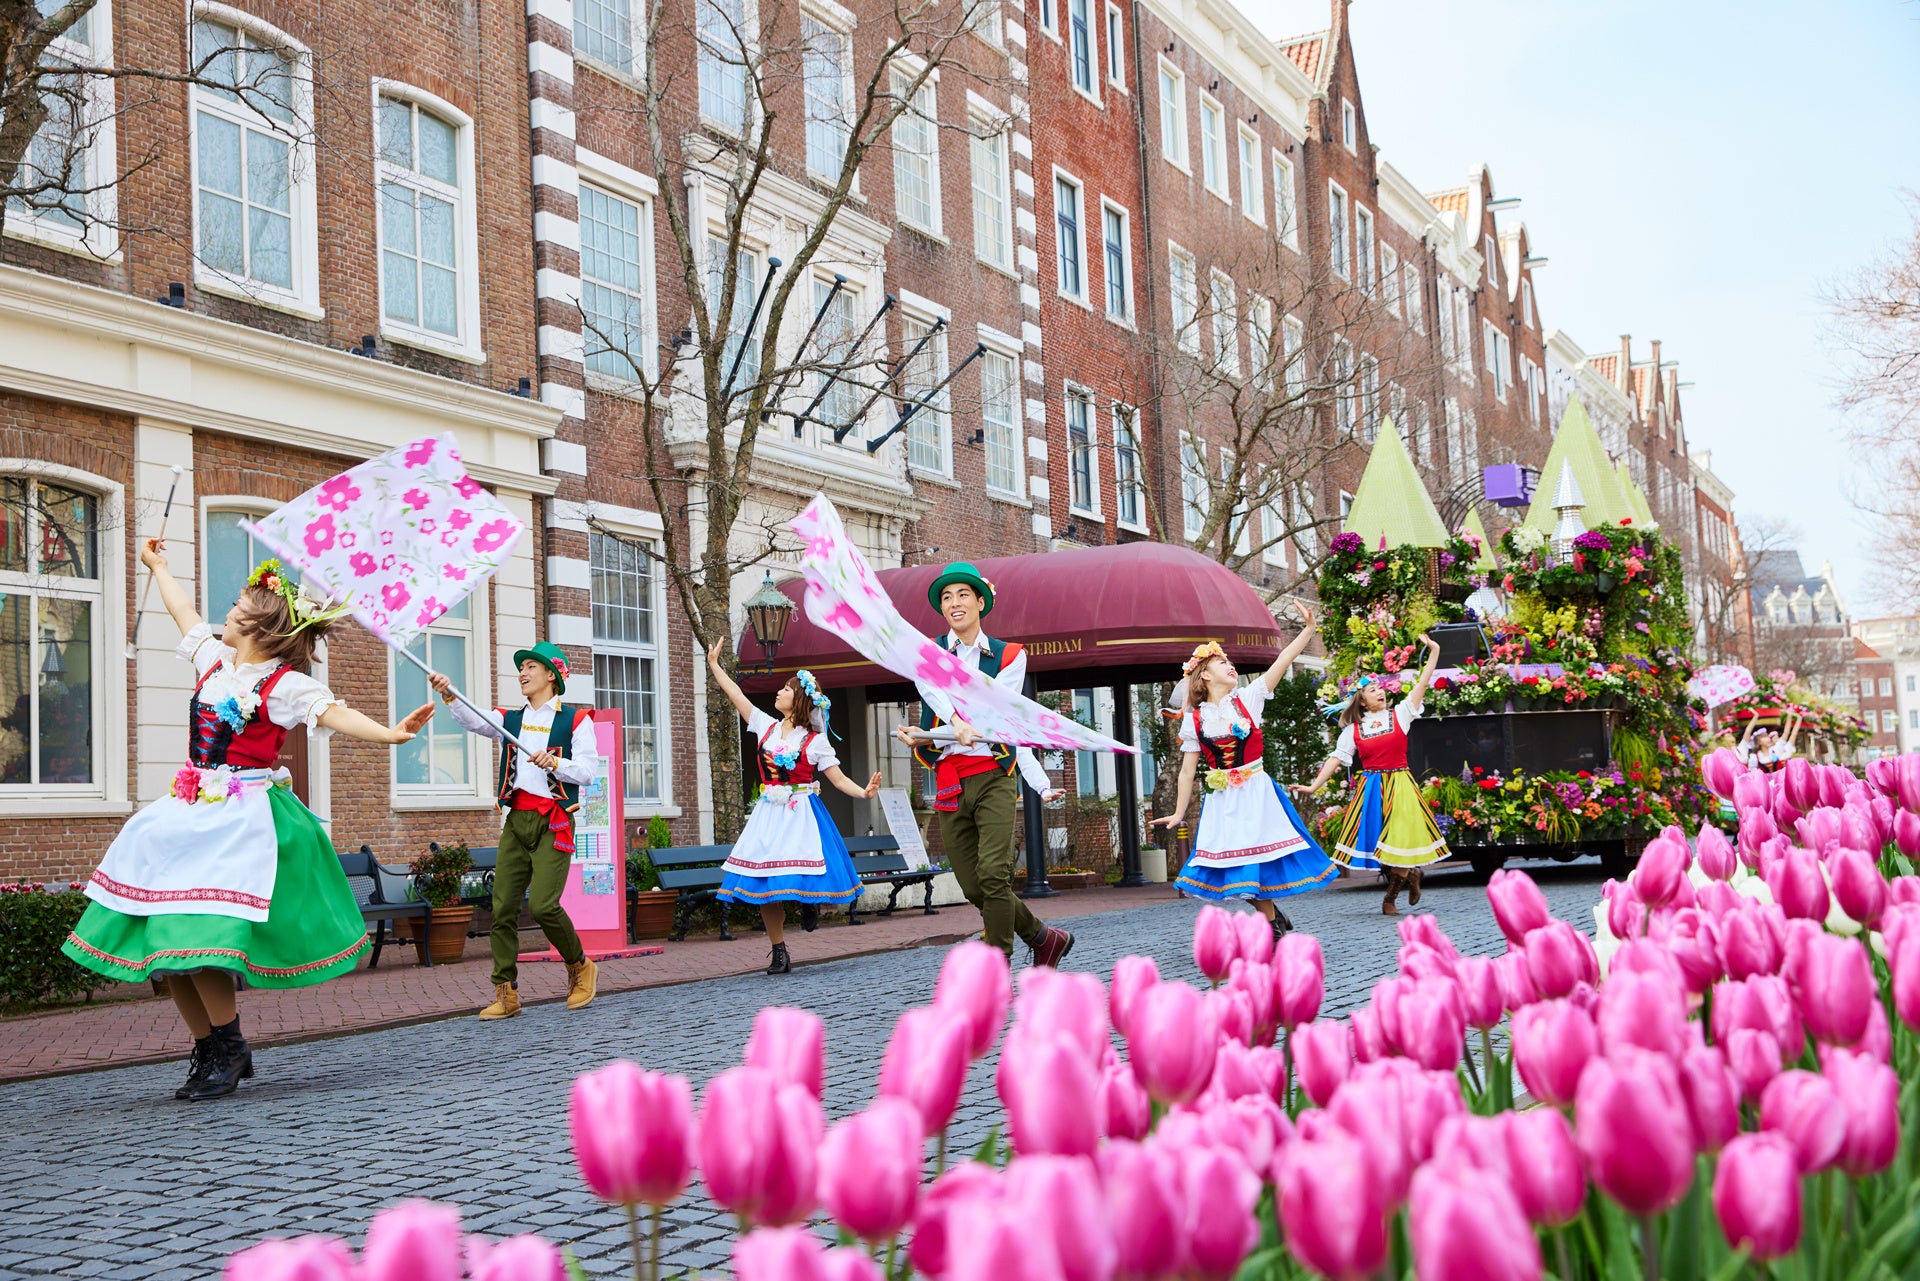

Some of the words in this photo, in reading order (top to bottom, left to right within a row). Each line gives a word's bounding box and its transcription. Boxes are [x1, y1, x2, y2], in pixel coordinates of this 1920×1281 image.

[759, 544, 790, 563] HTEL
[1023, 638, 1083, 656] STERDAM
[1236, 633, 1264, 647] HOTEL
